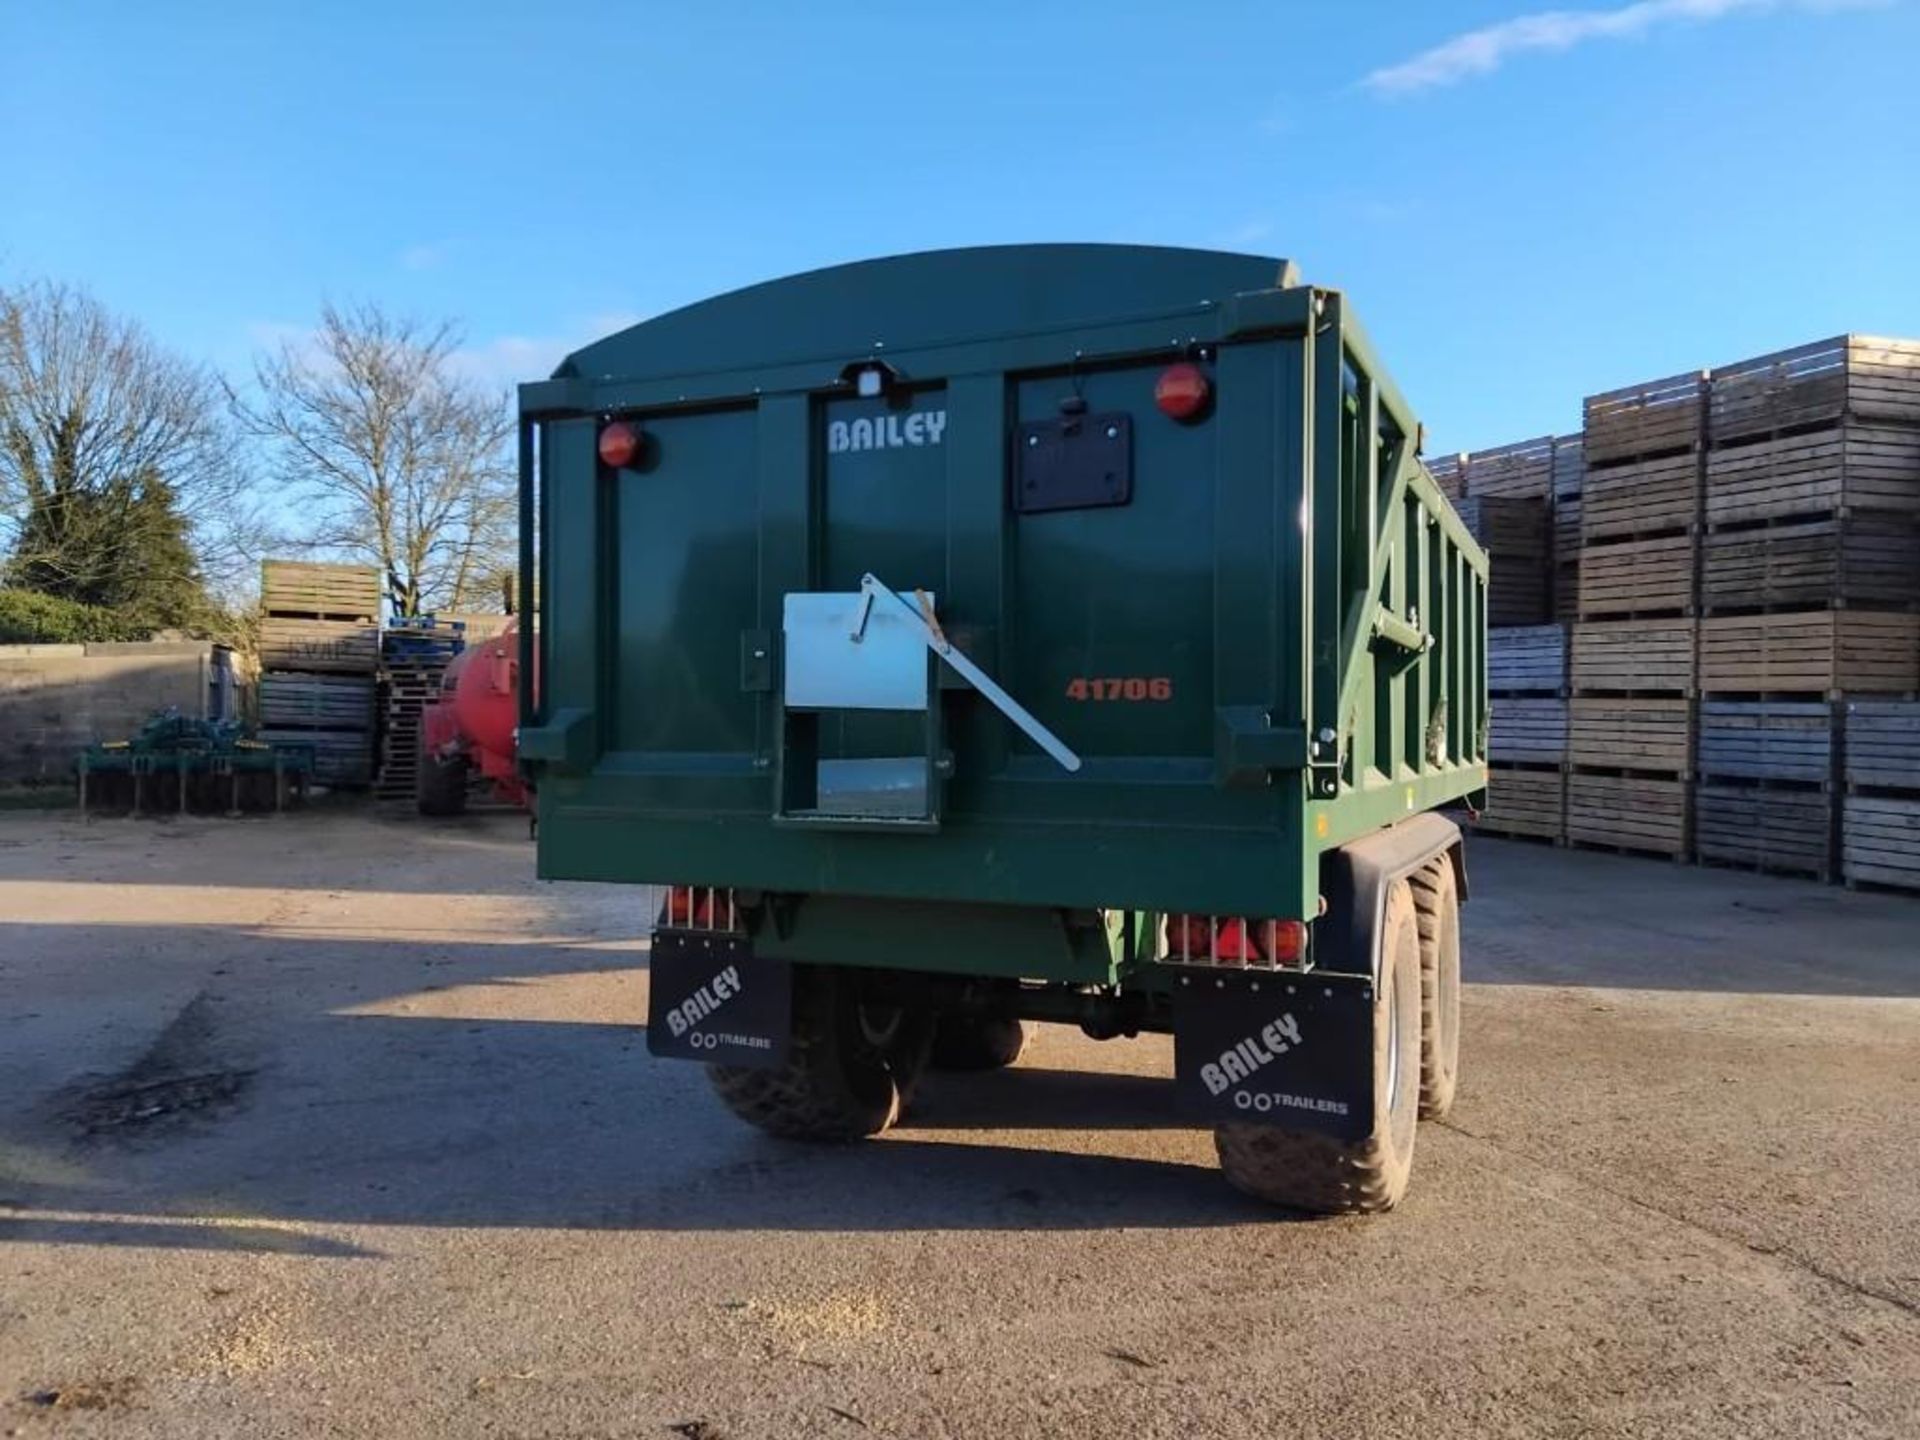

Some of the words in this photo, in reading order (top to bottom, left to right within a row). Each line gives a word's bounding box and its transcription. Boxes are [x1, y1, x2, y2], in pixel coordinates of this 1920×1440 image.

[828, 410, 946, 454] BAILEY
[1066, 678, 1170, 700] 41706
[666, 965, 741, 1037] BAILEY
[719, 1033, 771, 1049] TRAILERS
[1200, 1012, 1302, 1096] BAILEY
[1273, 1093, 1348, 1115] TRAILERS
